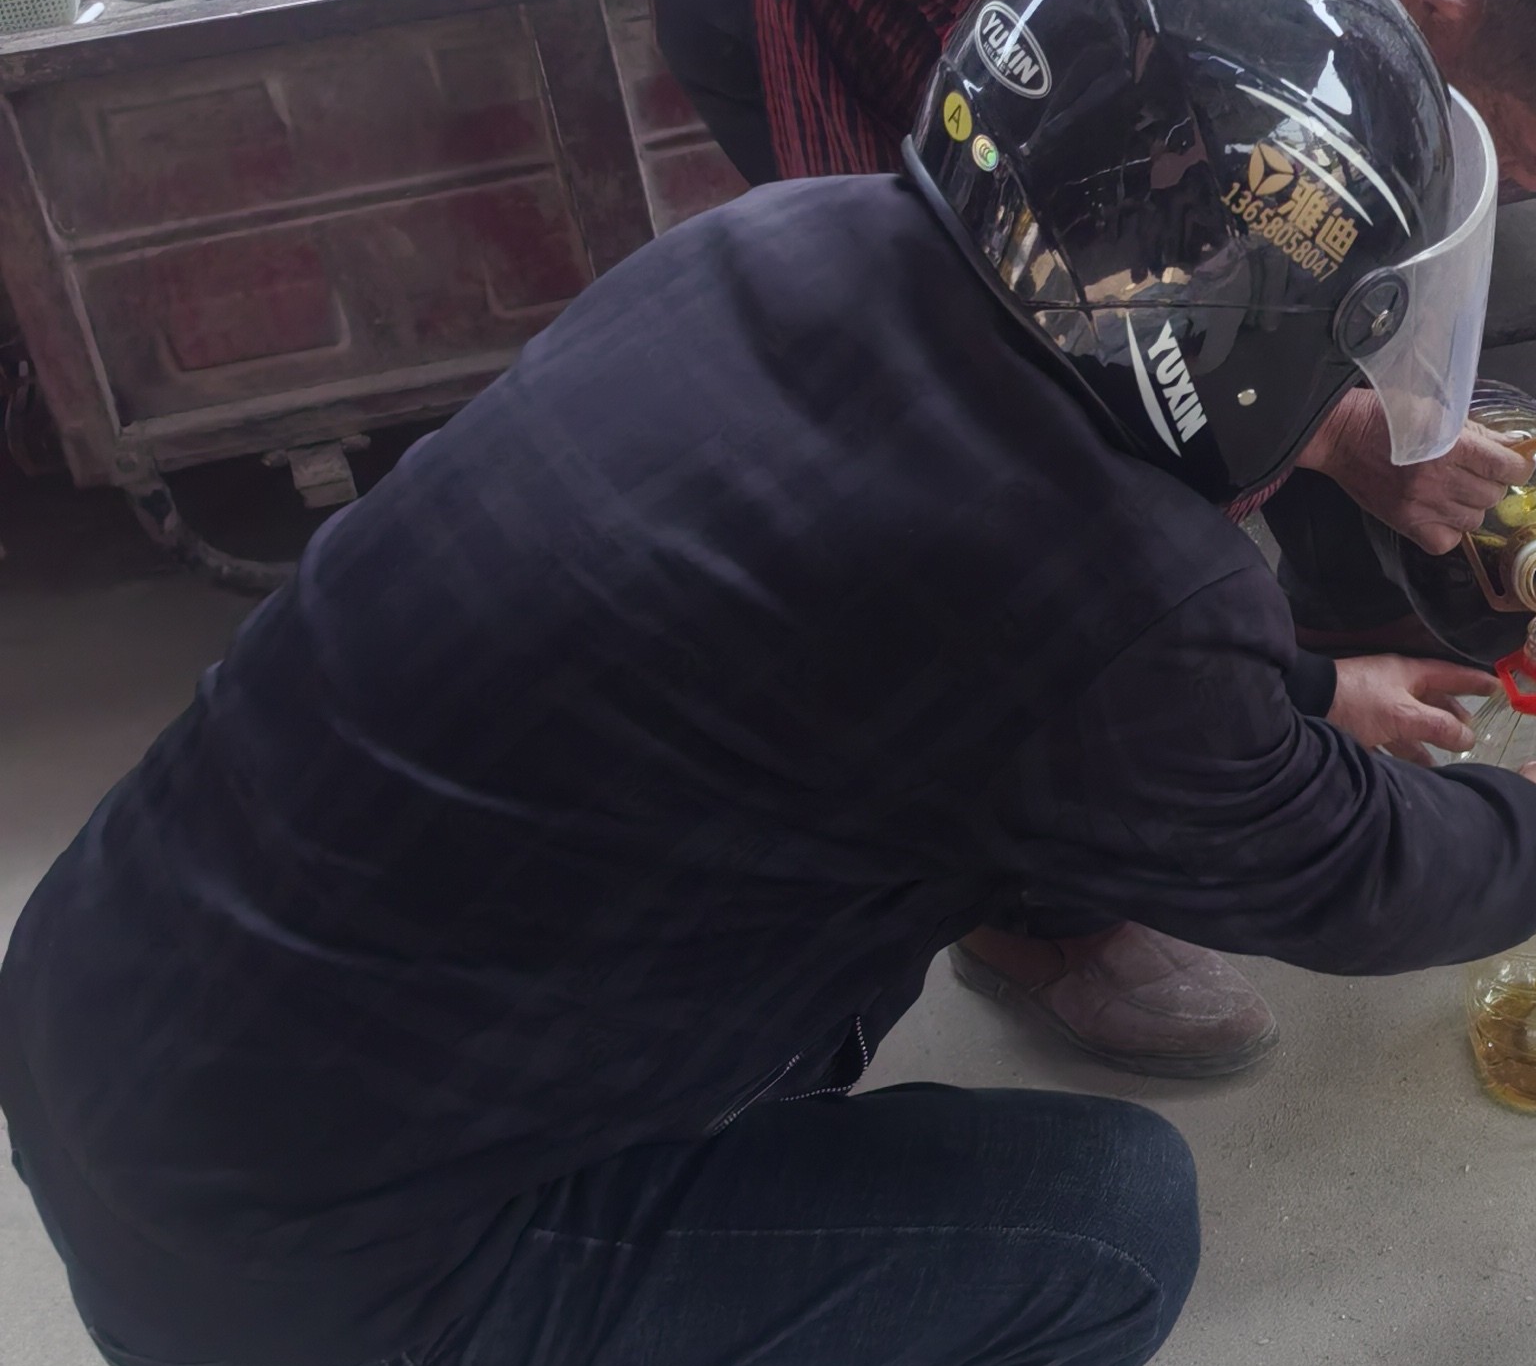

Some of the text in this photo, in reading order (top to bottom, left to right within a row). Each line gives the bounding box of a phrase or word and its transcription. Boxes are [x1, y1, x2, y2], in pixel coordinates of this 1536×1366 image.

[947, 104, 962, 134] A
[1220, 182, 1339, 283] 13658058047
[1277, 175, 1359, 264] 雅迪
[1147, 319, 1208, 443] YUXIN
